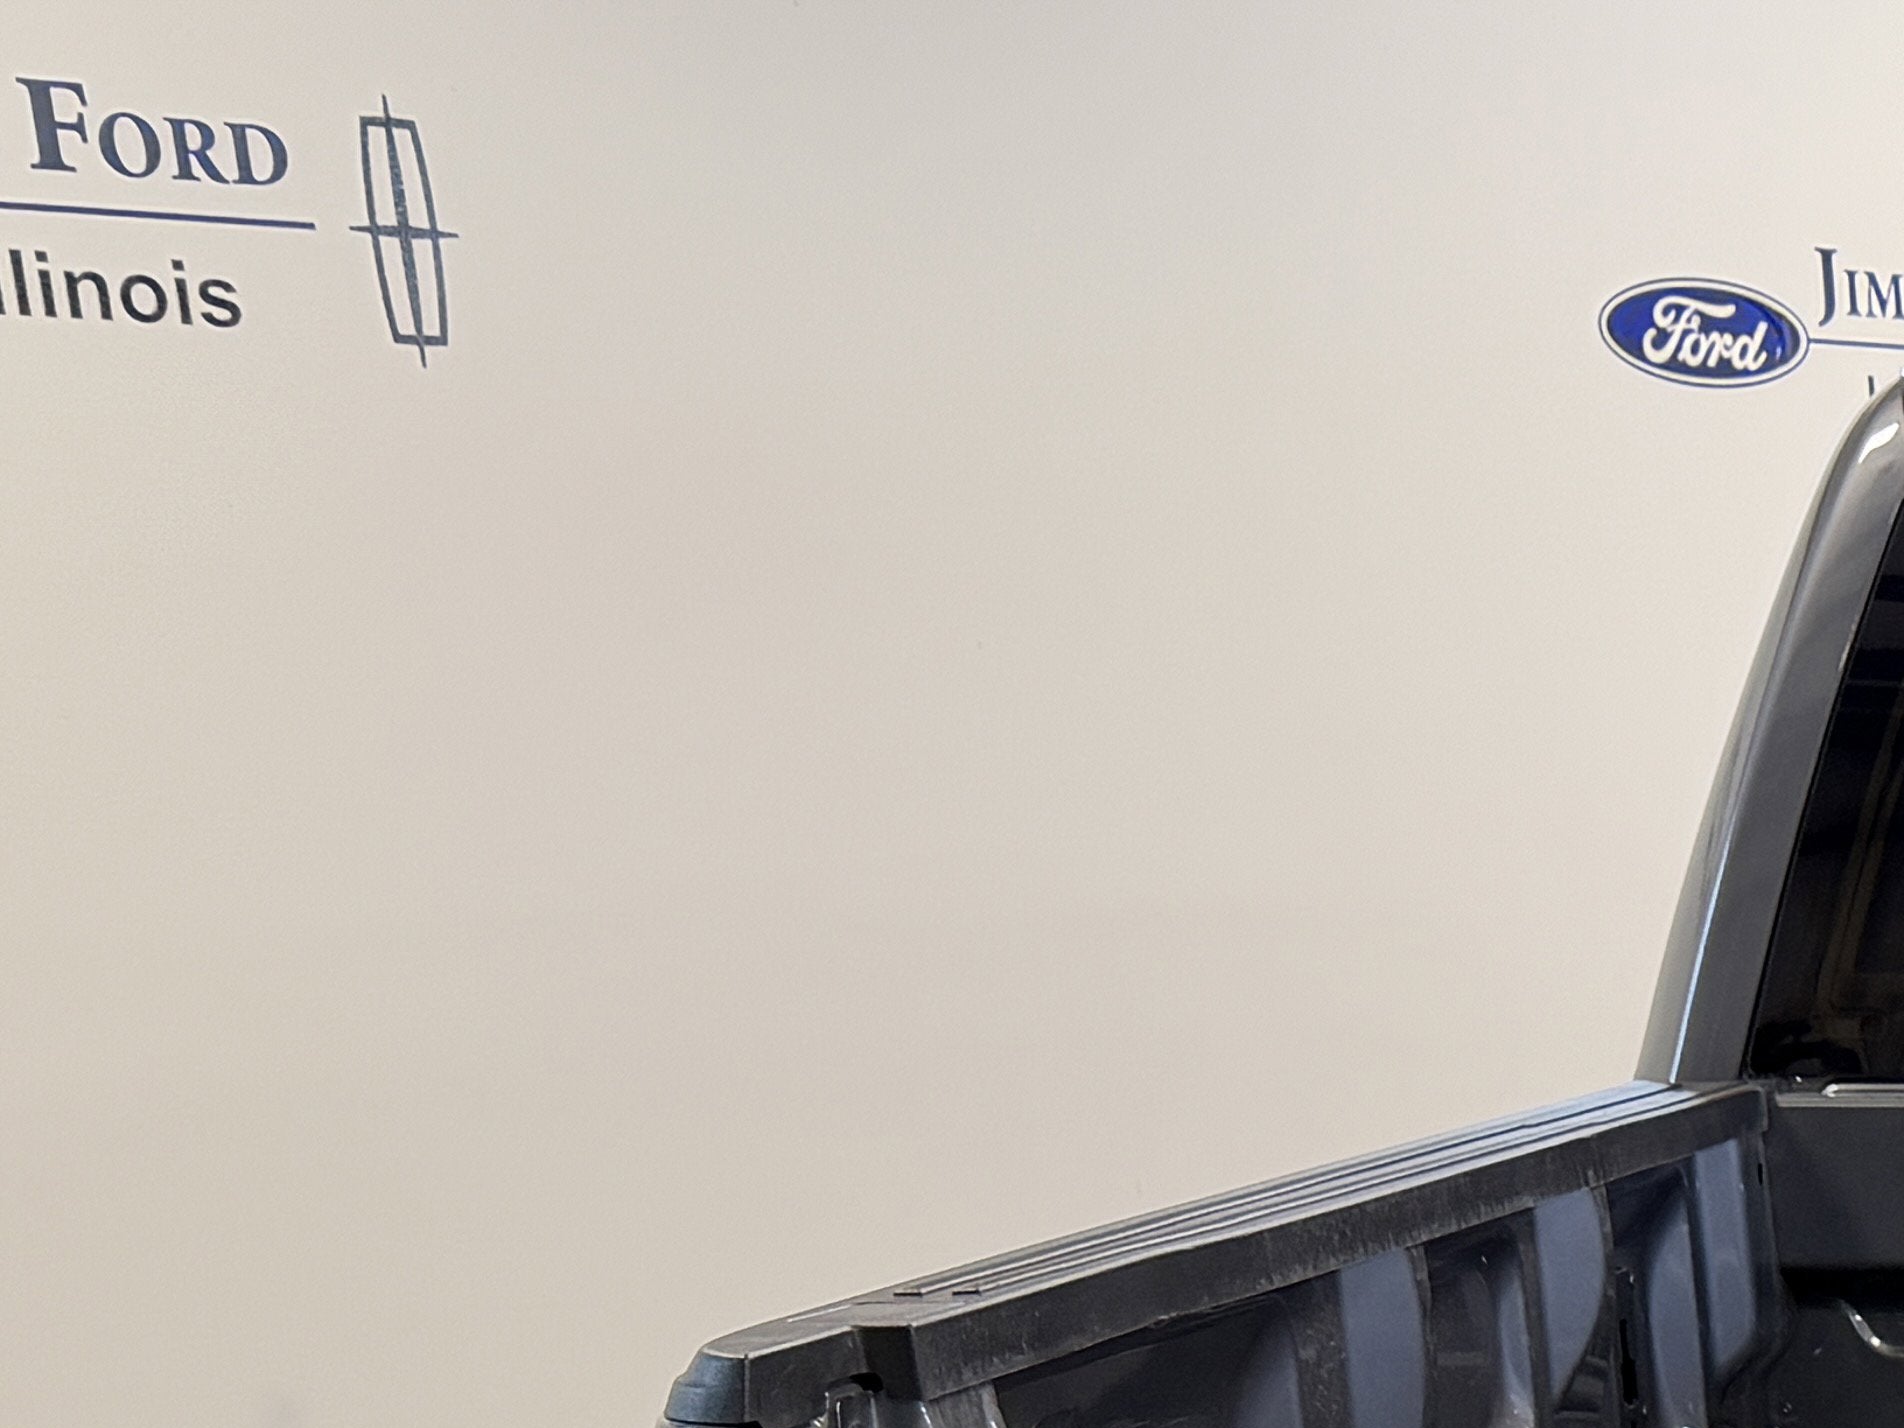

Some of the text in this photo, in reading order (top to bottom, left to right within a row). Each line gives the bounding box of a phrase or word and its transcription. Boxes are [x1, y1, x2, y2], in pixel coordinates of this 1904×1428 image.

[15, 76, 289, 186] FORD
[0, 248, 243, 329] linois
[1642, 295, 1769, 371] Ford
